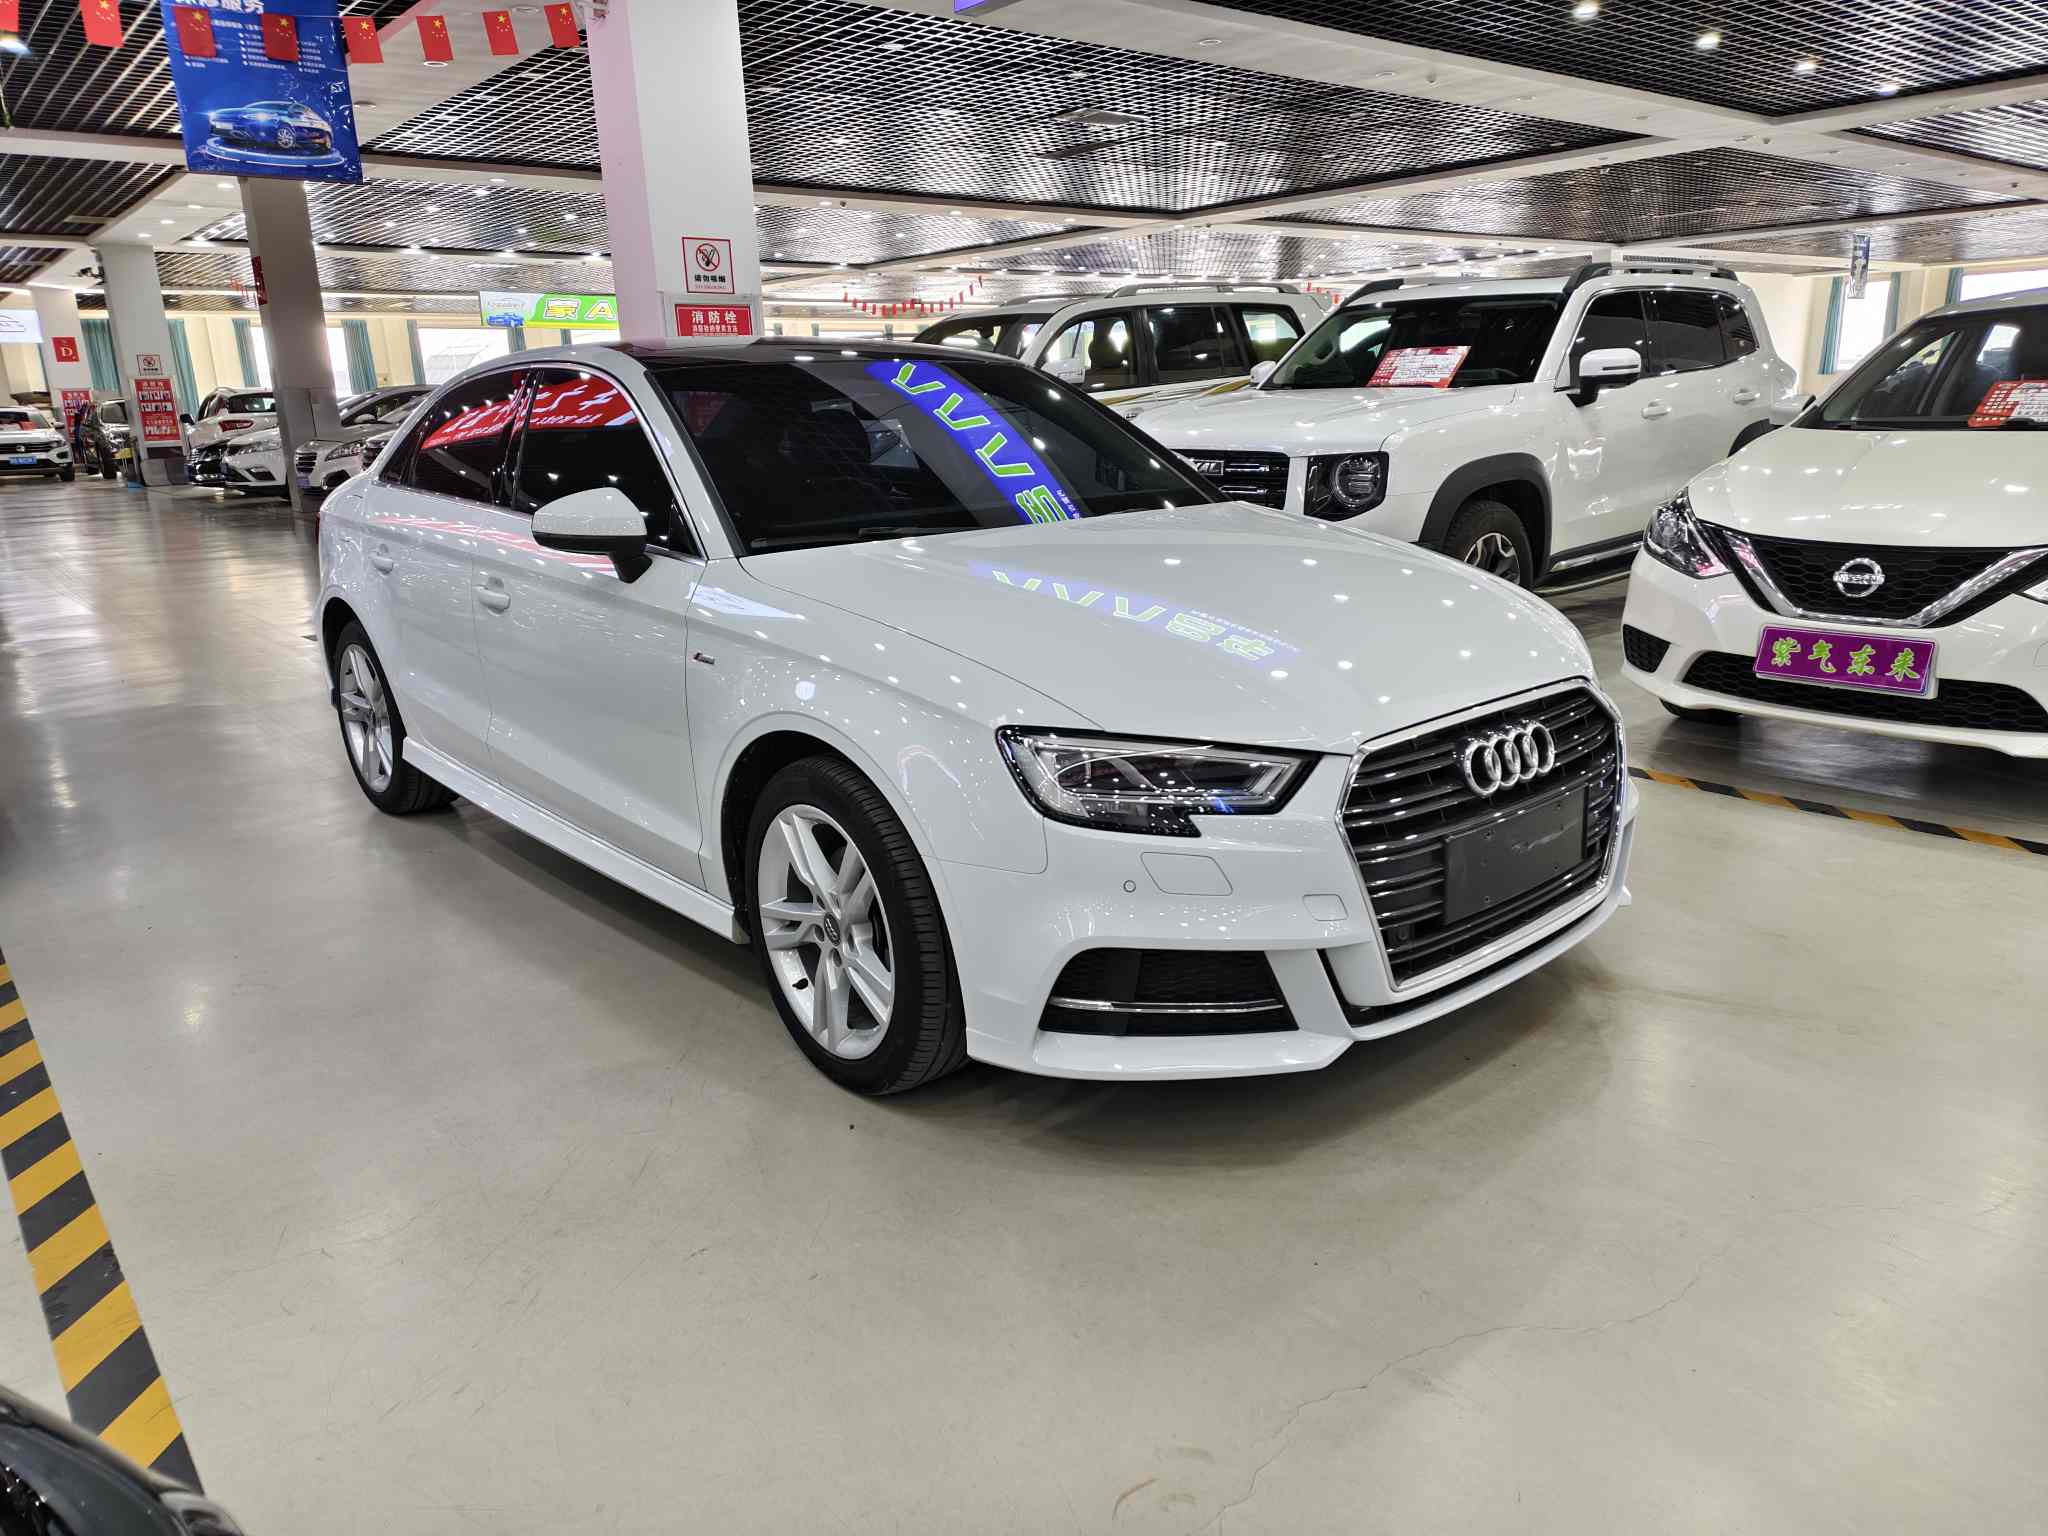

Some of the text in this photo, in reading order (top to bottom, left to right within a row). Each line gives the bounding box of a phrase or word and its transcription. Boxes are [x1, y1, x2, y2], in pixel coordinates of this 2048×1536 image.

[691, 310, 737, 324] 消防栓
[1838, 572, 1880, 585] NISSAN
